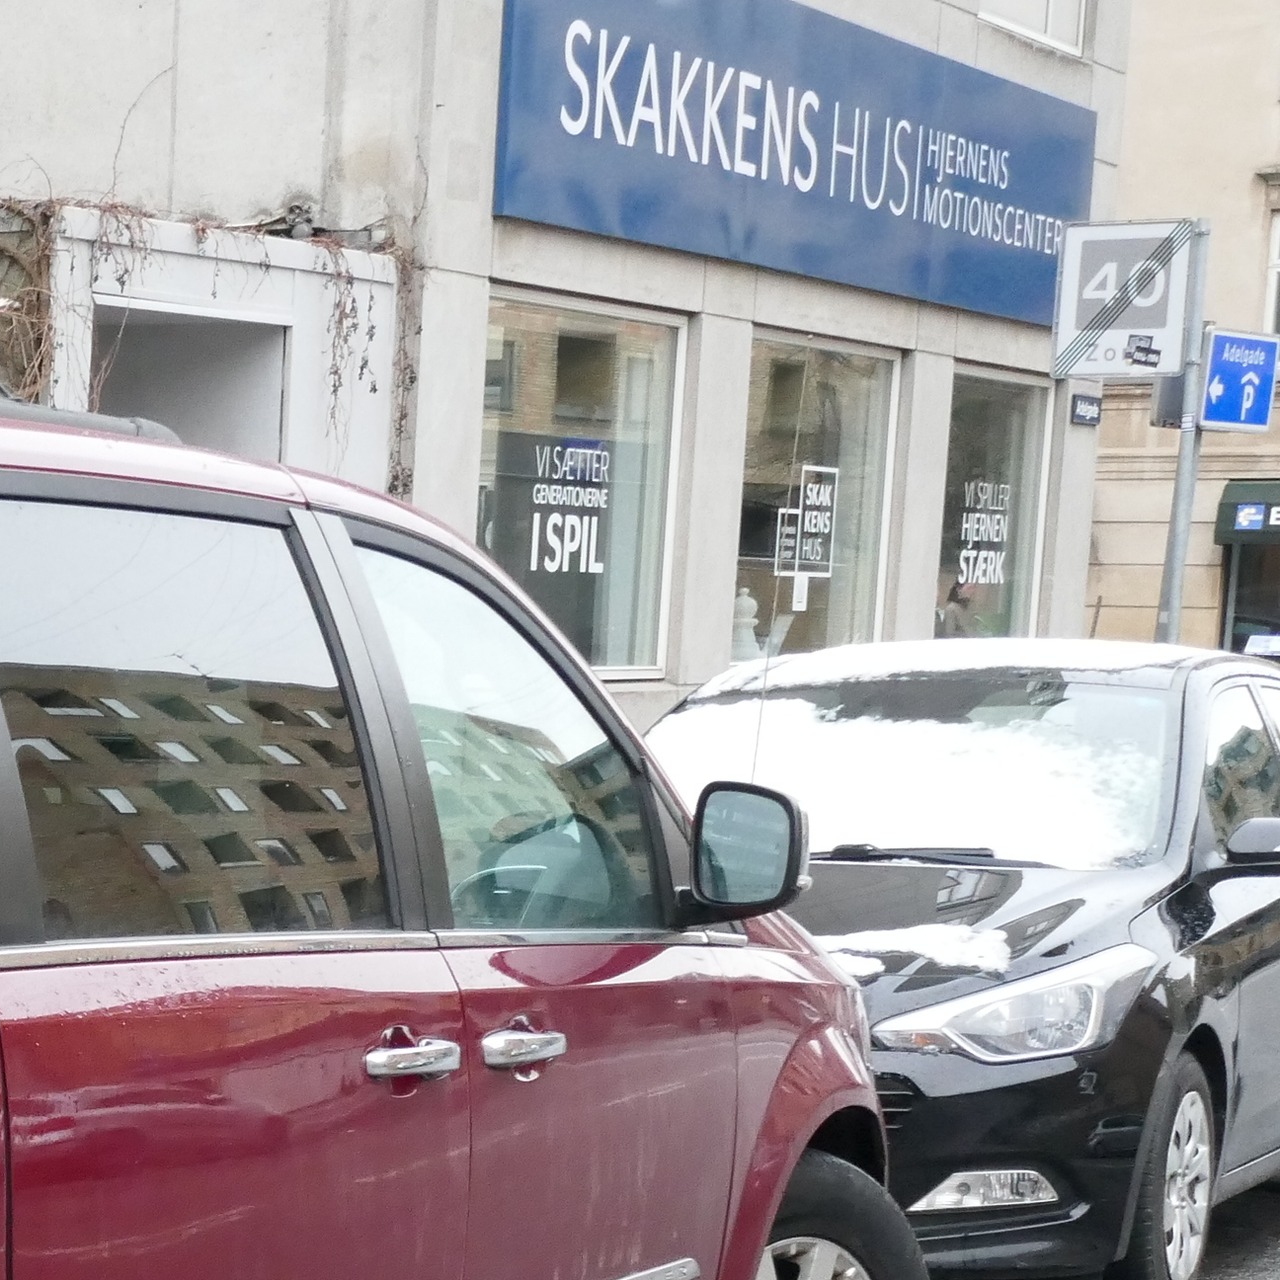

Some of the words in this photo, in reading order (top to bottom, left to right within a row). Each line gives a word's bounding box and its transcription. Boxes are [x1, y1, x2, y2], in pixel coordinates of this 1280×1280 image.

[560, 19, 820, 193] SKAKKENS
[830, 101, 913, 218] HUS
[926, 127, 1011, 191] HJERNENS
[923, 185, 1064, 256] MOTIONSCENTER
[1082, 261, 1166, 308] 40
[1222, 343, 1266, 367] Adelgade
[1241, 384, 1255, 421] P
[536, 445, 551, 478] VI
[552, 446, 610, 482] SÆTTER
[805, 483, 832, 506] SKAK
[803, 510, 831, 533] KENS
[961, 512, 1008, 549] HJERNEN
[530, 512, 541, 572] I
[544, 512, 604, 573] SPIL
[801, 538, 823, 560] HUS
[958, 549, 1006, 584] STÆRK
